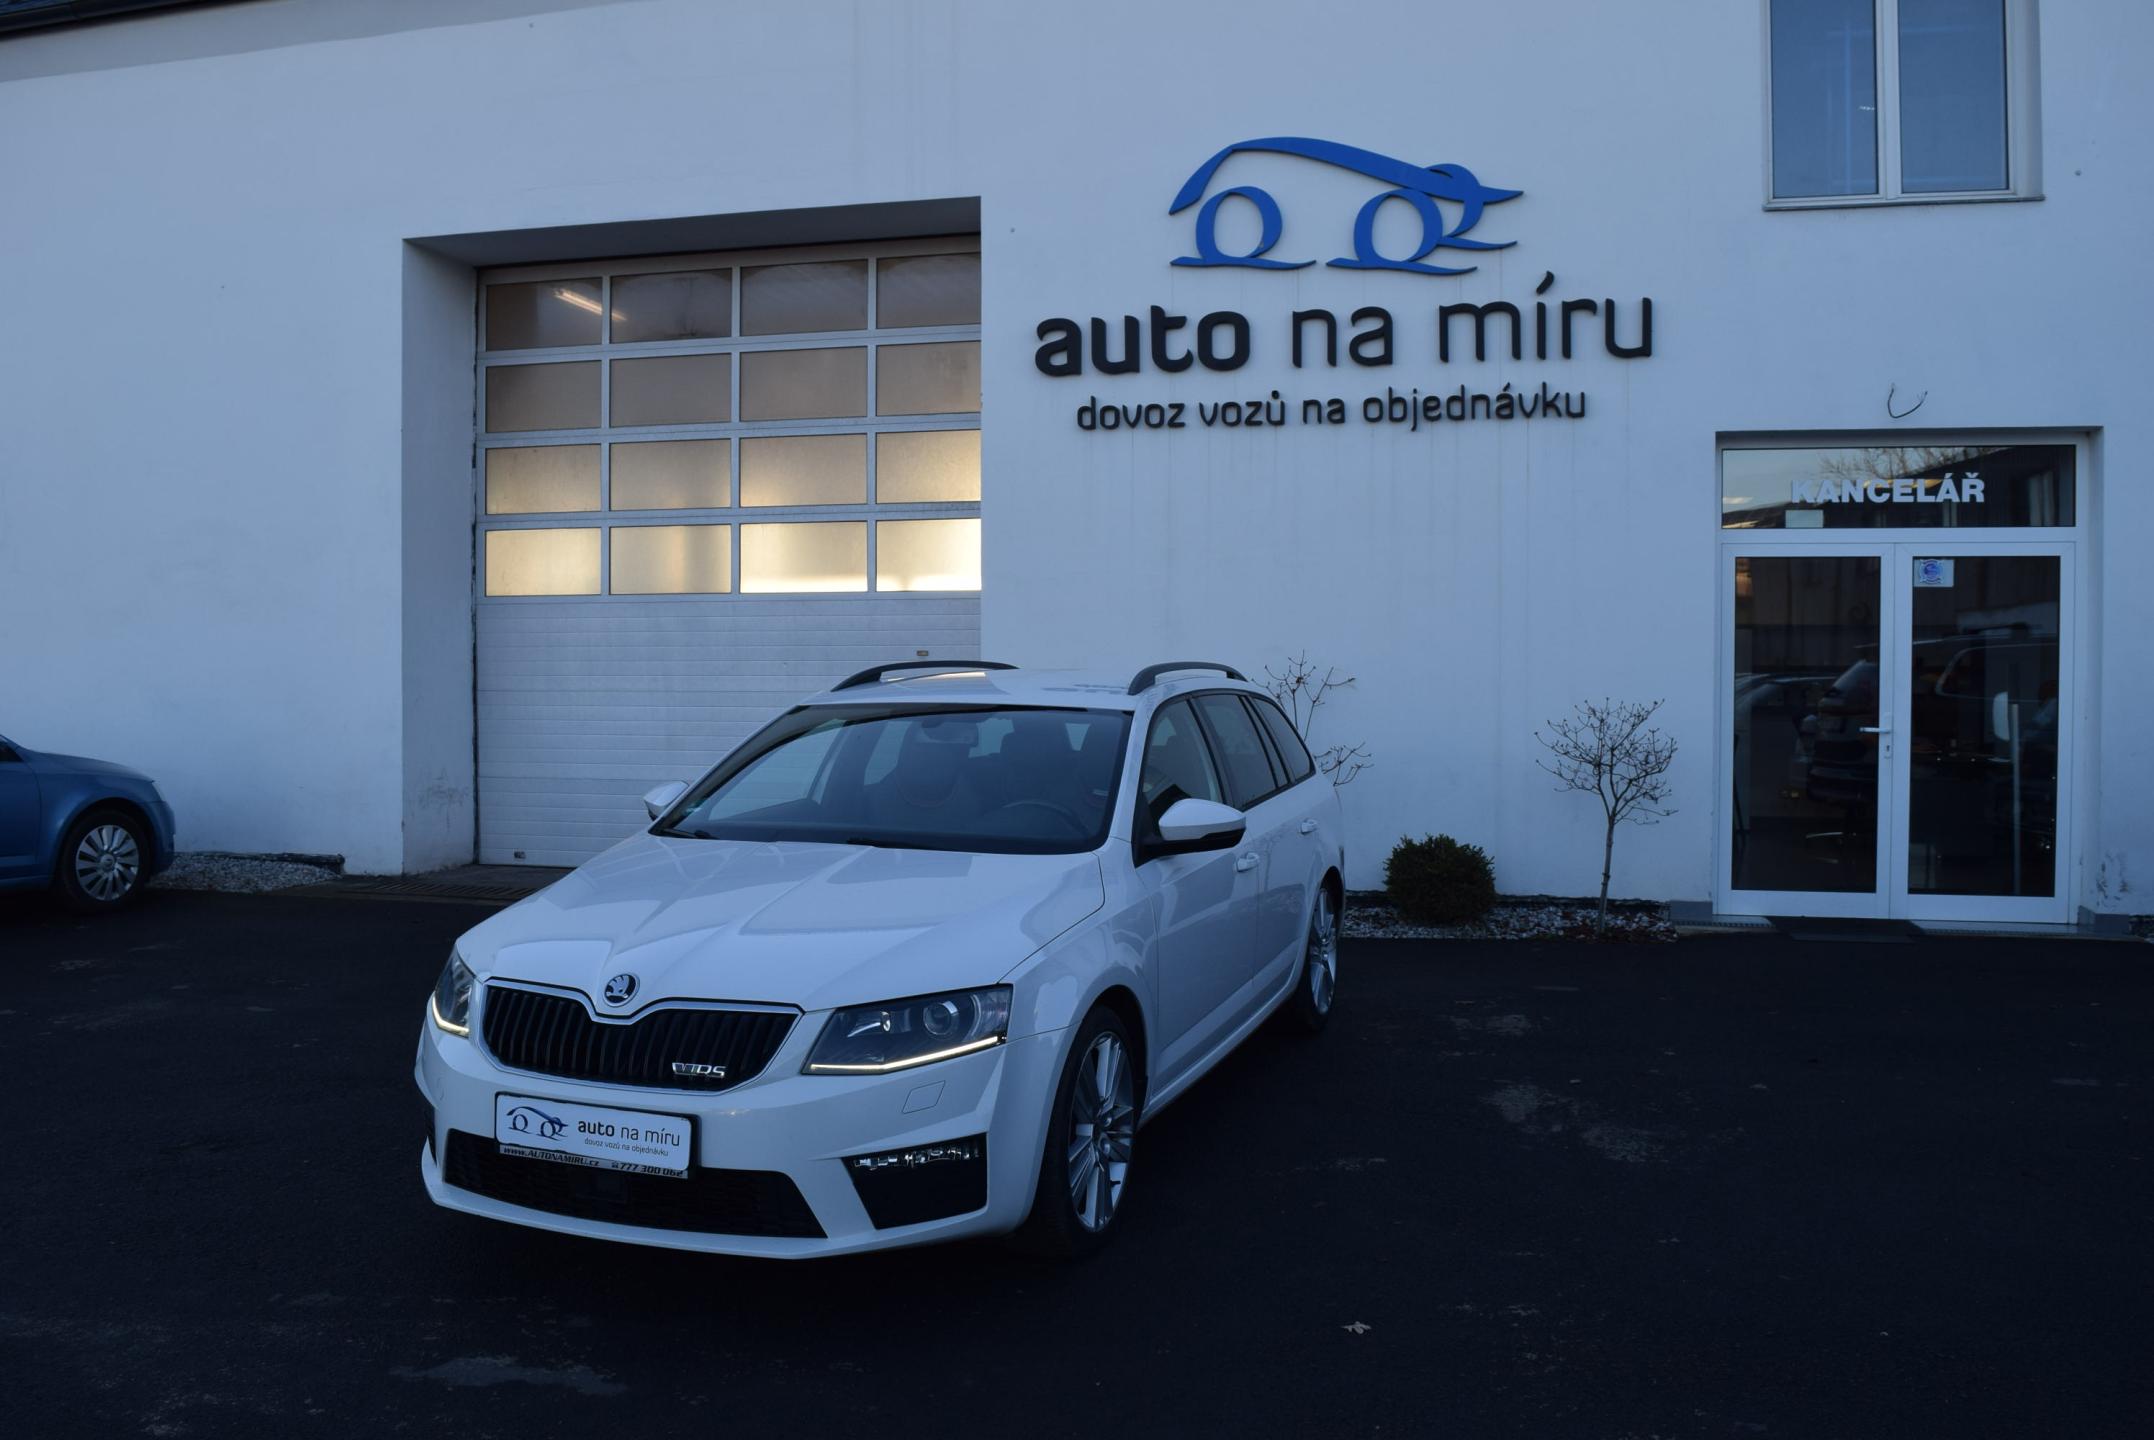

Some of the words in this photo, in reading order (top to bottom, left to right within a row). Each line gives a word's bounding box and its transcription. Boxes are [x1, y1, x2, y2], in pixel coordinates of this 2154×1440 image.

[1035, 305, 1250, 377] auto
[1292, 307, 1394, 368] na
[1438, 271, 1652, 363] míru
[1077, 396, 1186, 431] dovoz
[1199, 390, 1286, 428] vozů
[1302, 399, 1346, 425] na
[1362, 382, 1586, 432] objednávku
[1791, 472, 1984, 504] KANCELÁŘ
[578, 1120, 615, 1137] auto
[621, 1127, 639, 1141] na
[645, 1128, 680, 1146] míru
[585, 1138, 603, 1147] dovoz
[605, 1142, 620, 1150] vozů
[632, 1144, 668, 1156] objednávku
